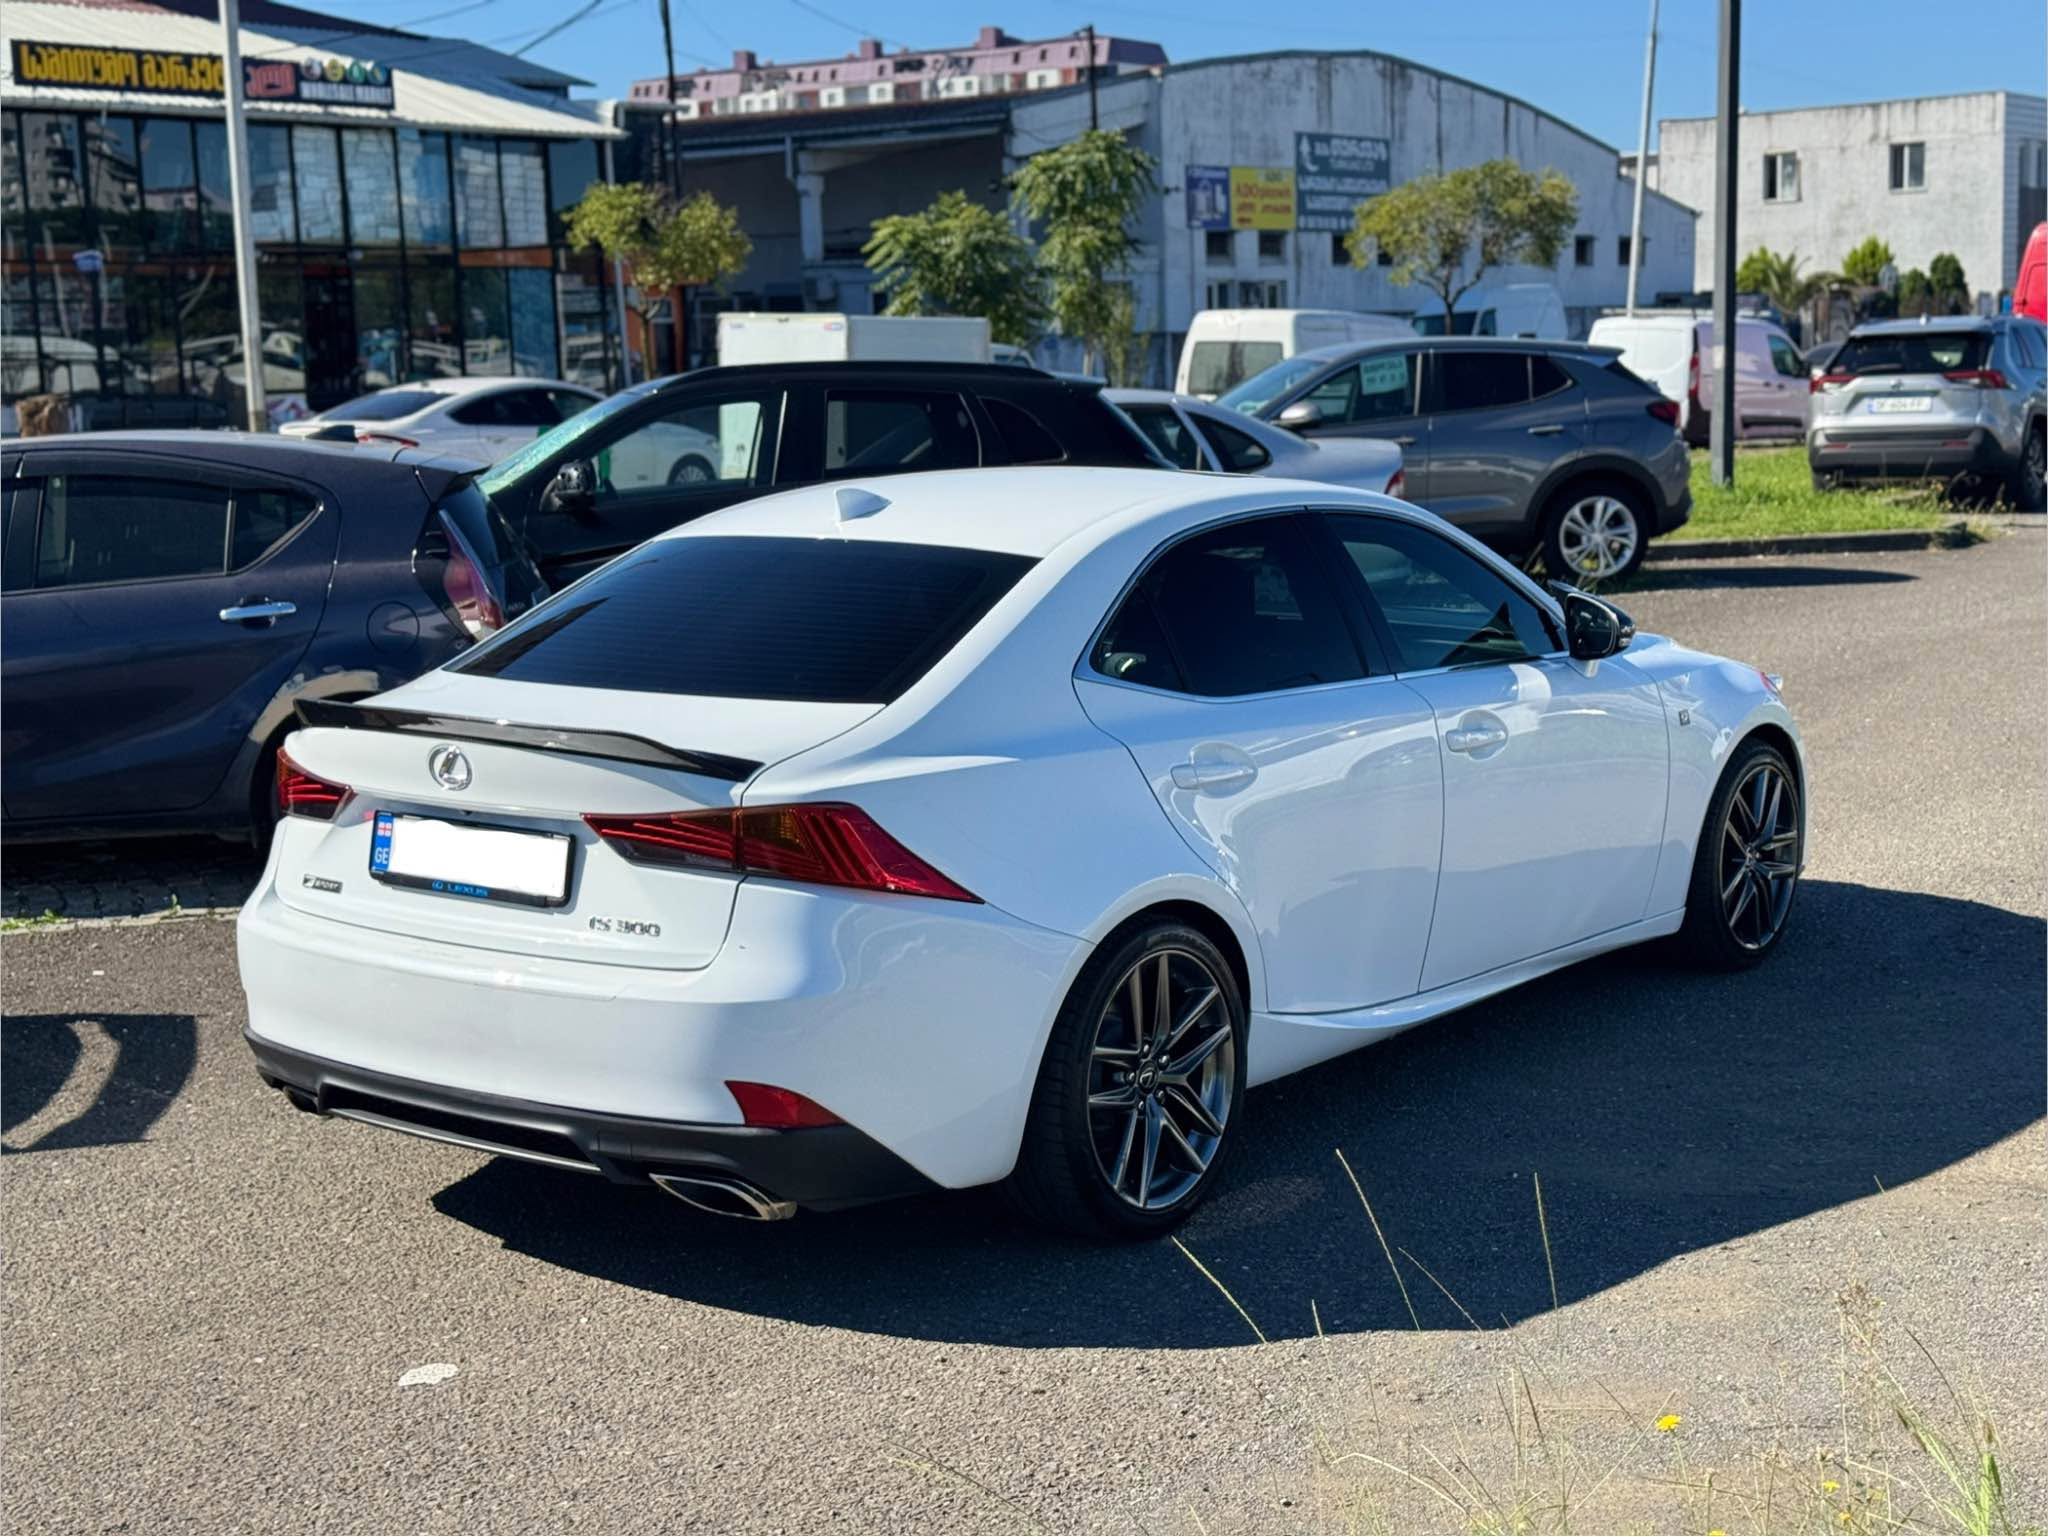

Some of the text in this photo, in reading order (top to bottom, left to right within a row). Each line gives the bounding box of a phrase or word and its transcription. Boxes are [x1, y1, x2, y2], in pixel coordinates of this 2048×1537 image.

[374, 847, 389, 864] GE
[447, 883, 488, 896] LEXUS
[589, 915, 661, 937] IS 300
